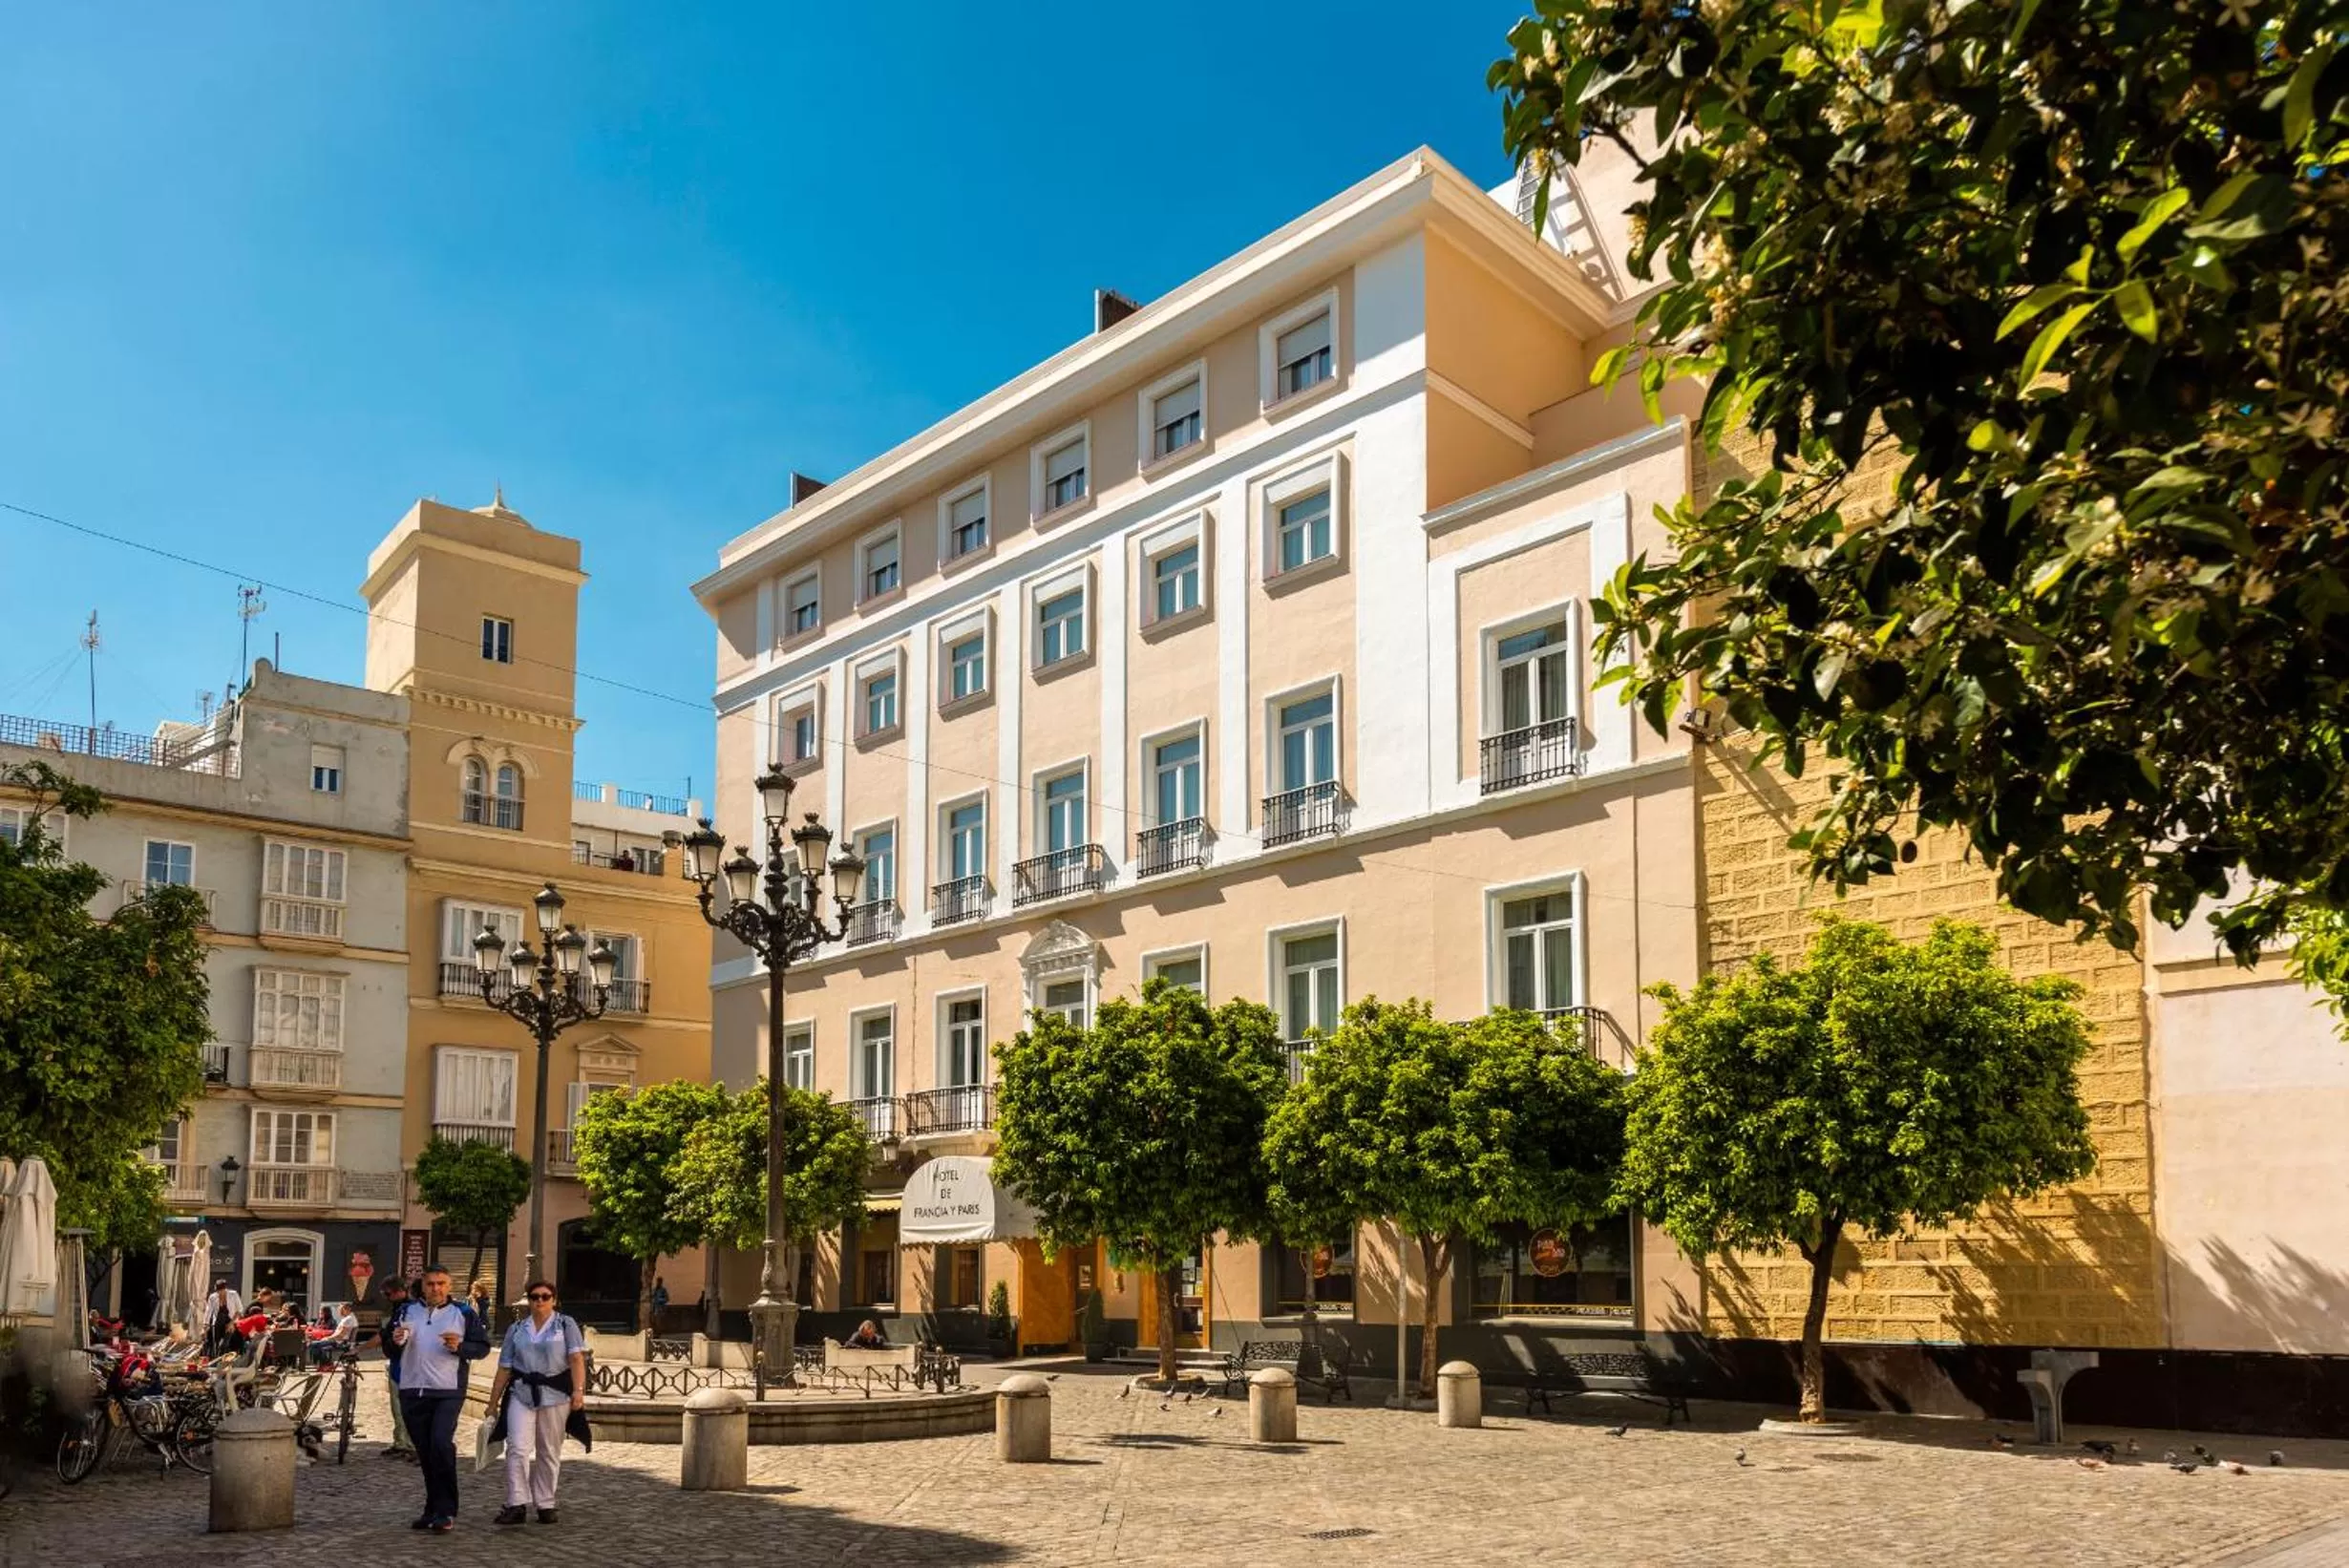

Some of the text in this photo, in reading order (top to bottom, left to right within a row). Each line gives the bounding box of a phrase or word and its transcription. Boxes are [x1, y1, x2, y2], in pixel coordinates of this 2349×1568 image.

[941, 1188, 951, 1198] DE
[914, 1203, 980, 1218] FRANCIA Y PARIS
